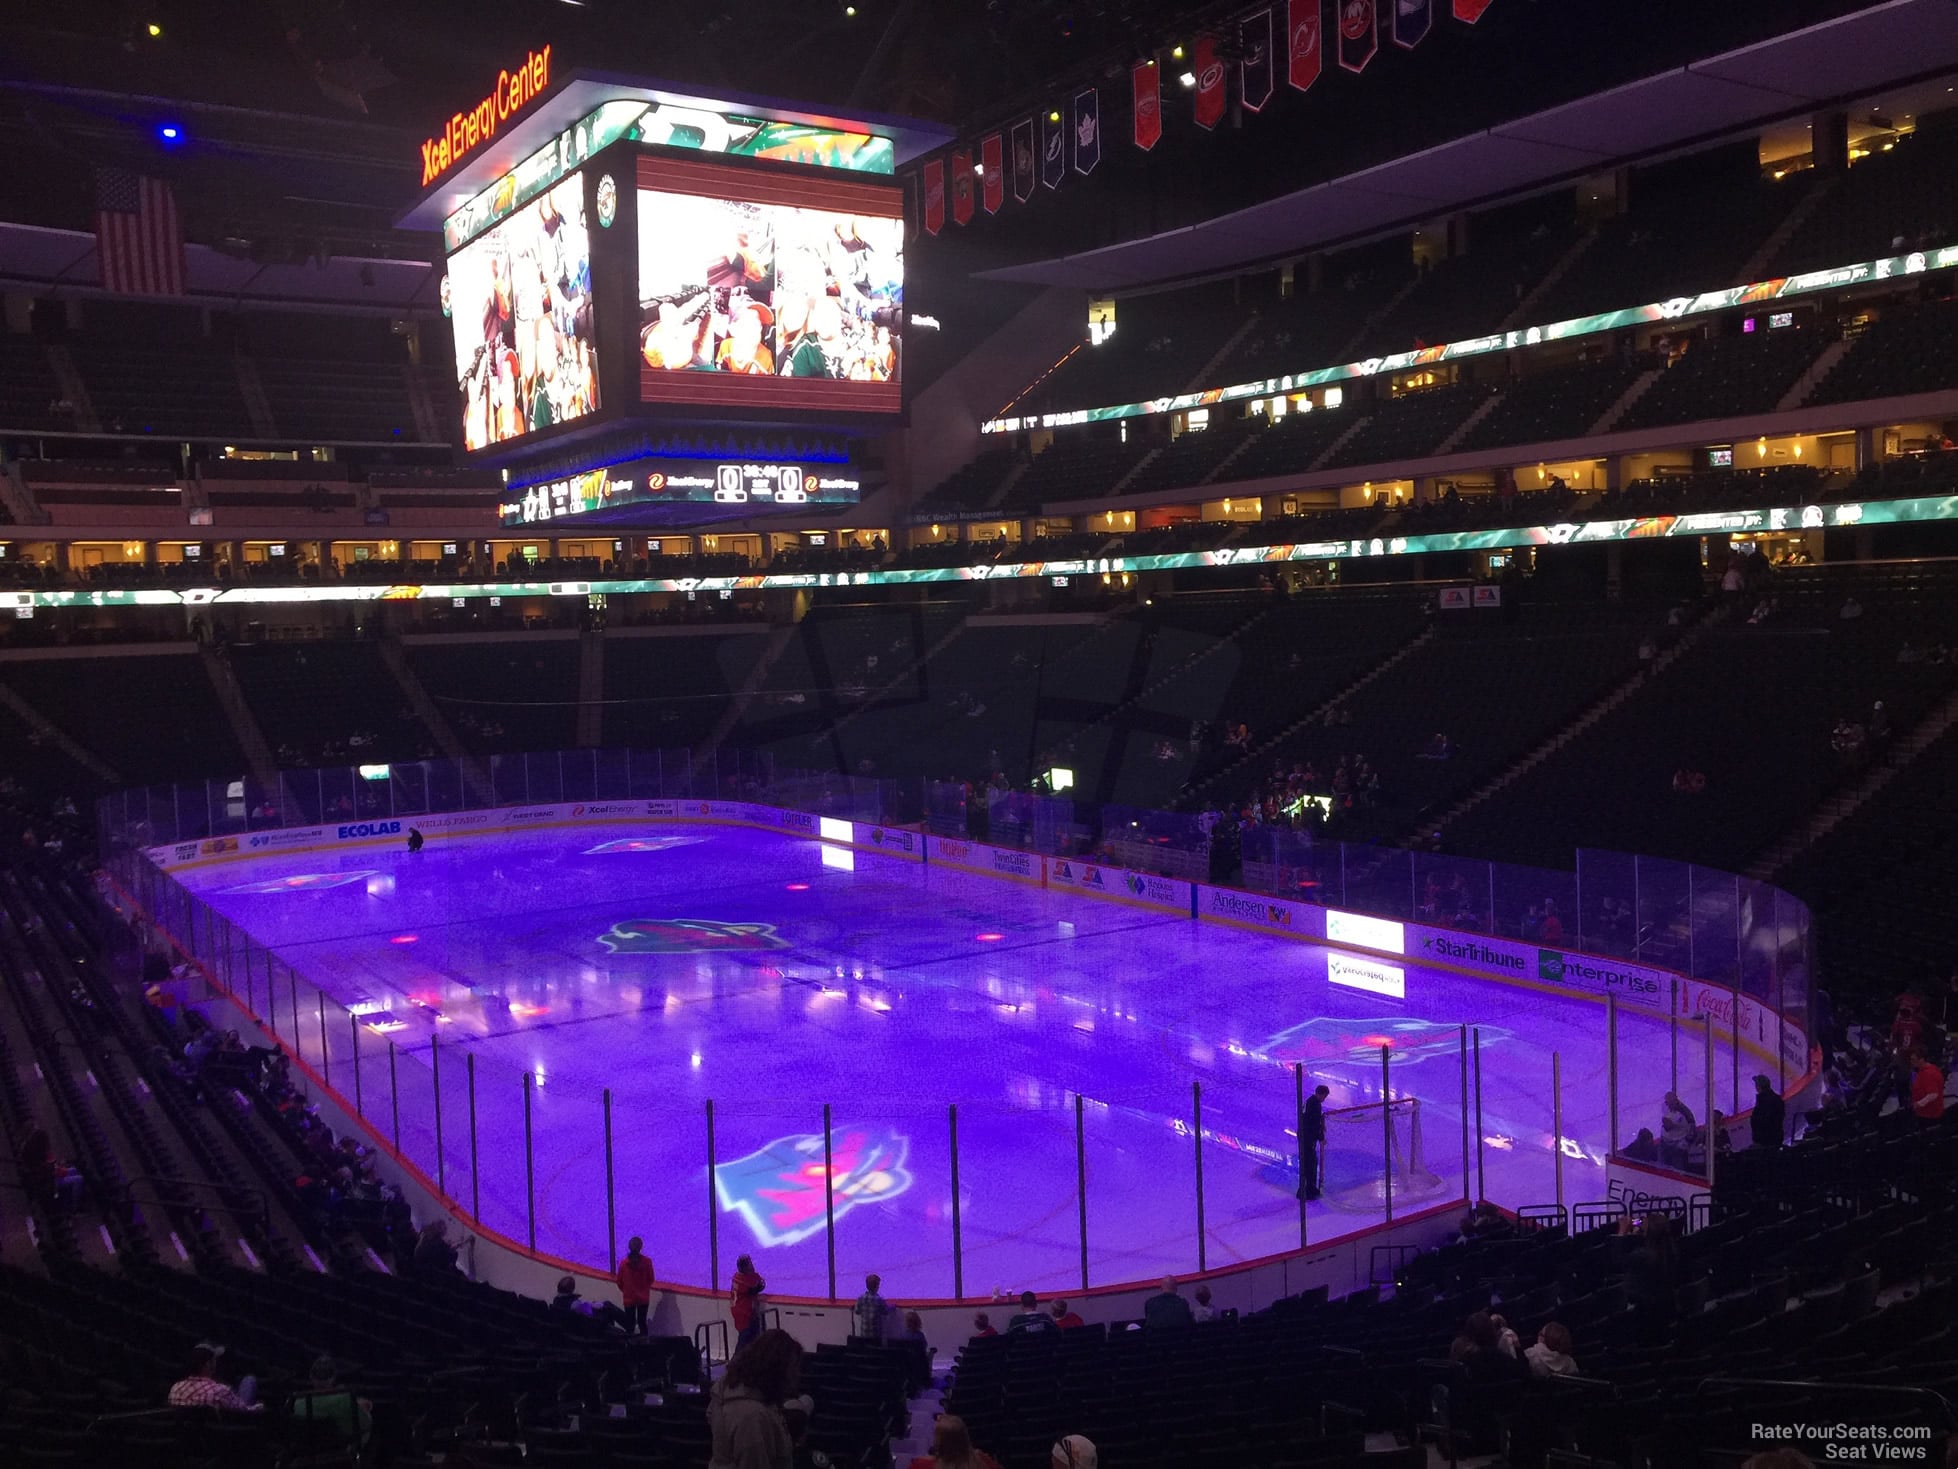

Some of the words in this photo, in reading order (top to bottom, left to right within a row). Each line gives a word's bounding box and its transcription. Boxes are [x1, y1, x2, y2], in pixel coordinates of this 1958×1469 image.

[421, 121, 451, 187] Xcel
[452, 91, 497, 161] Energy
[498, 43, 551, 120] Center
[338, 821, 401, 839] ECOLAB
[416, 819, 452, 829] WELLS
[454, 815, 488, 826] FARGO
[1214, 891, 1265, 913] Andersen
